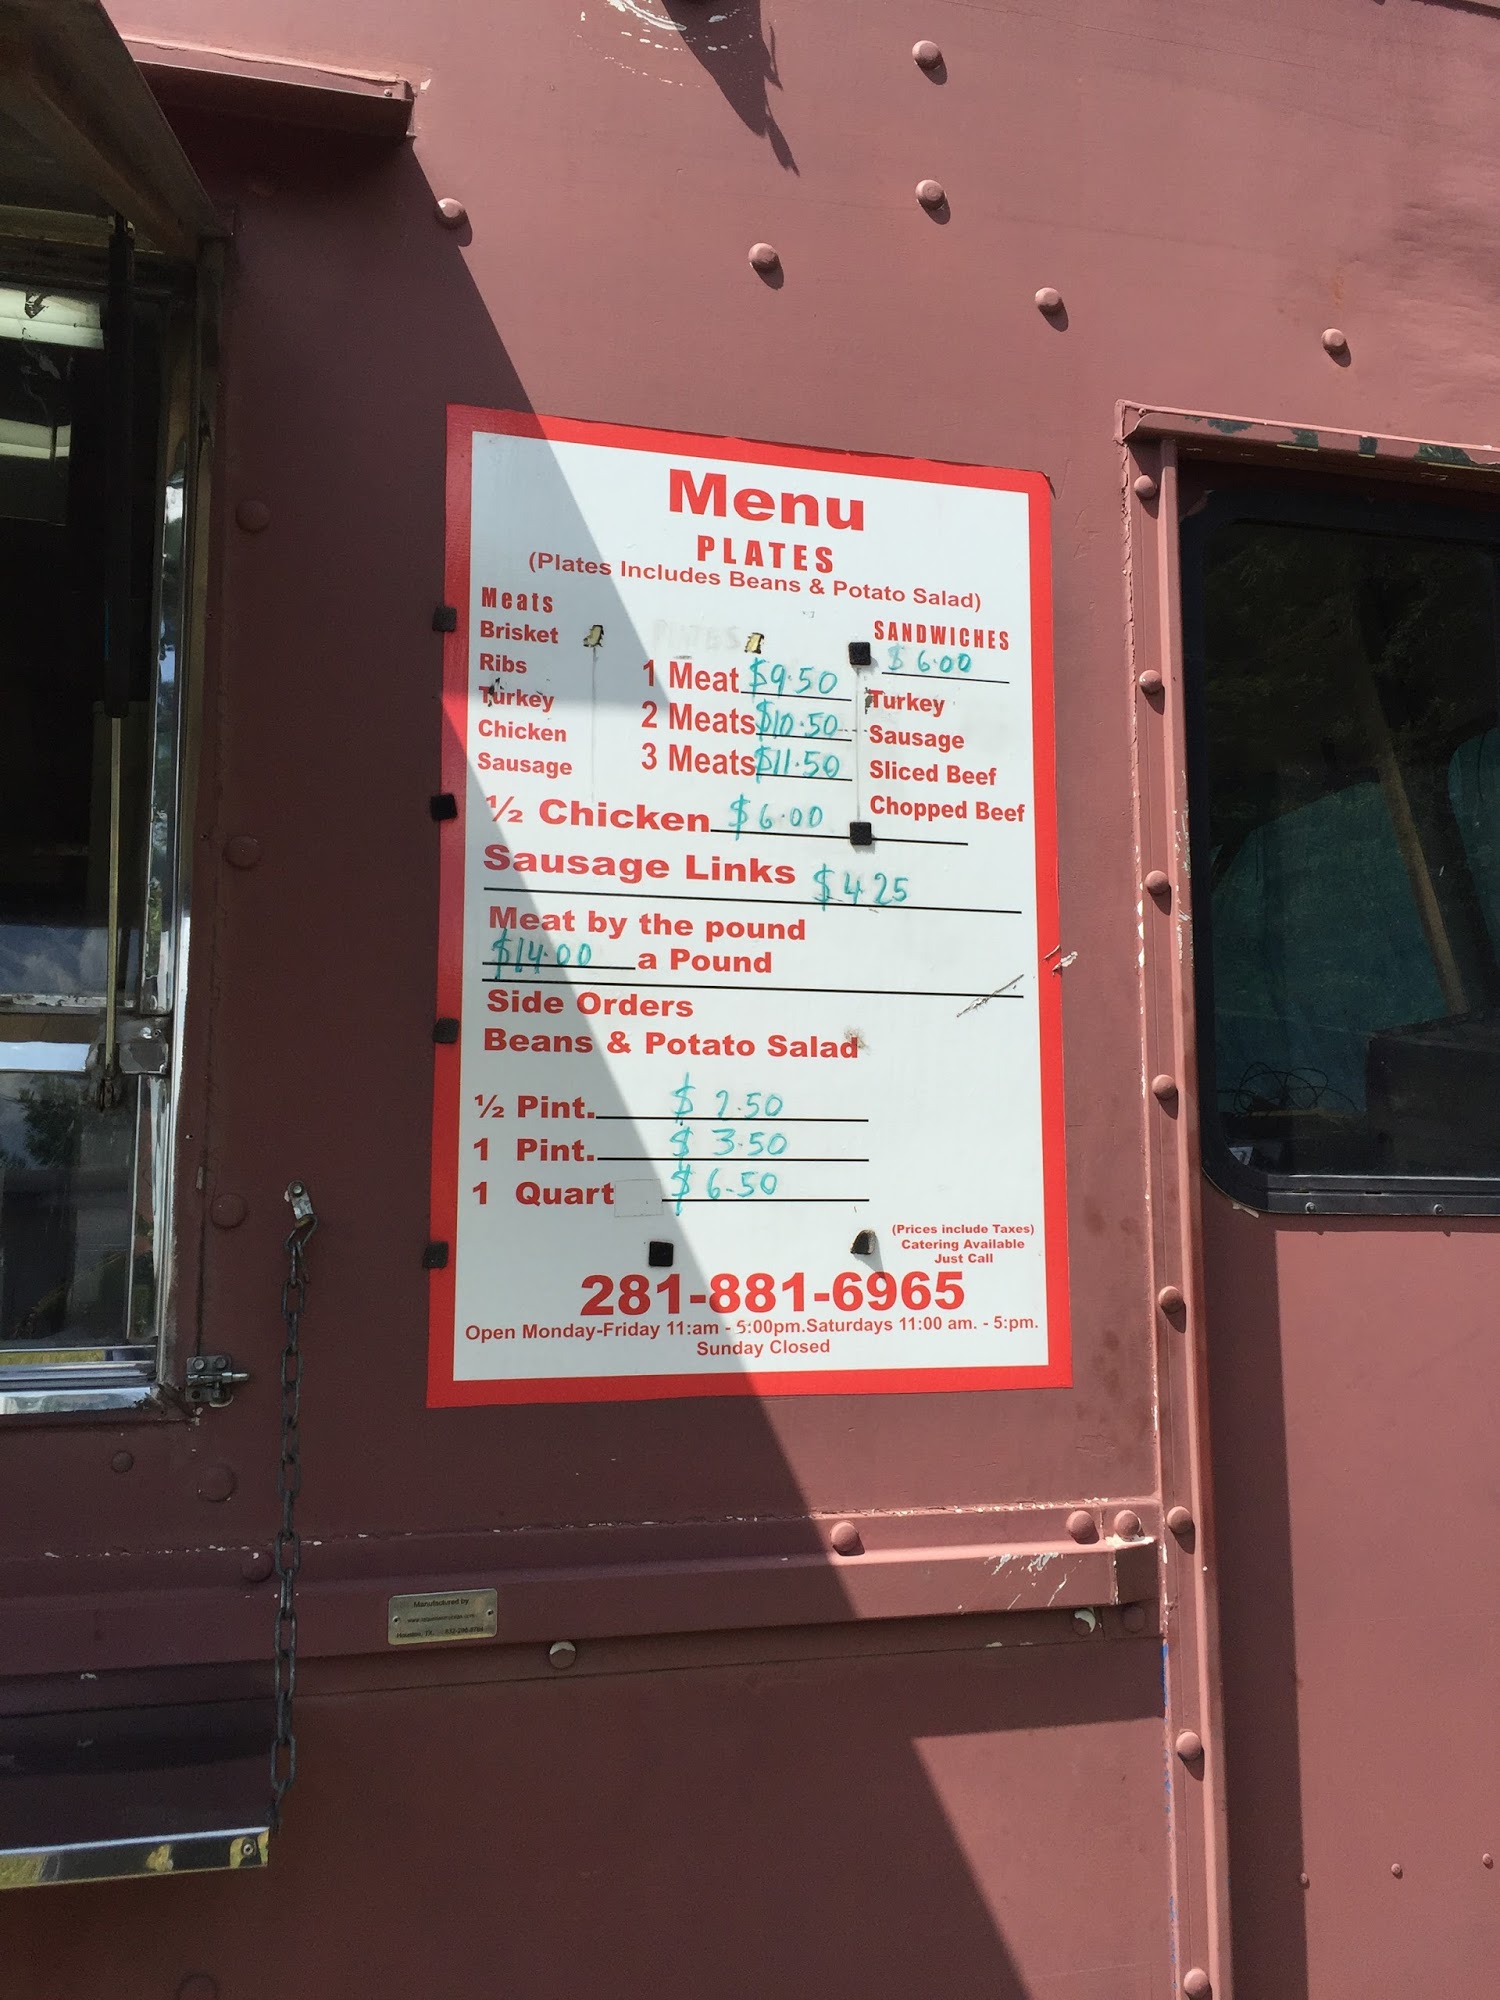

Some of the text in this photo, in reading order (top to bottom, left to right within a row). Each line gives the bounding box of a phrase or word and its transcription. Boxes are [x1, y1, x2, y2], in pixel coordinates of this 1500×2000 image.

[669, 466, 866, 531] Menu
[695, 535, 833, 575] PLATES
[530, 553, 981, 611] (Plates Includes Beans & Potato Salad)
[482, 587, 553, 612] Meats
[481, 621, 557, 643] Brisket
[874, 620, 1009, 650] SANDWICHES
[481, 654, 526, 672] Ribs
[645, 660, 739, 693] 1 Meat
[749, 657, 838, 701] $9.50
[479, 686, 554, 713] Turkey
[869, 689, 945, 717] Turkey
[478, 719, 566, 742] Chicken
[642, 702, 755, 735] 2 Meats
[756, 699, 839, 741] $10.50
[869, 724, 964, 753] Sausage
[478, 752, 572, 779] Sausage
[642, 742, 755, 776] 3 Meats
[754, 745, 840, 783] $11.50
[870, 759, 996, 785] Sliced Beef
[539, 799, 710, 832] Chicken
[870, 795, 1024, 822] Chopped Beef
[485, 845, 796, 884] Sausage Links
[491, 907, 805, 943] Meat by the pound
[638, 948, 772, 973] a Pound
[488, 989, 693, 1018] Side Orders
[485, 1028, 858, 1059] Beans & Potato Salad
[518, 1096, 594, 1118] Pint.
[474, 1138, 594, 1161] 1 Pint.
[473, 1181, 613, 1205] 1 Quart
[892, 1224, 1034, 1234] (Prices include Taxes)
[901, 1239, 1024, 1251] Catering Available
[935, 1254, 993, 1263] Just Call
[581, 1271, 965, 1318] 281-881-6965
[466, 1326, 514, 1342] Open
[523, 1322, 658, 1339] Monday-Friday
[669, 1322, 718, 1334] 11:am
[900, 1316, 942, 1330] 11:00
[948, 1320, 978, 1330] am.
[994, 1316, 1039, 1332] 5:pm.
[698, 1340, 830, 1358] Sunday Closed
[413, 1598, 460, 1608] Manufactured
